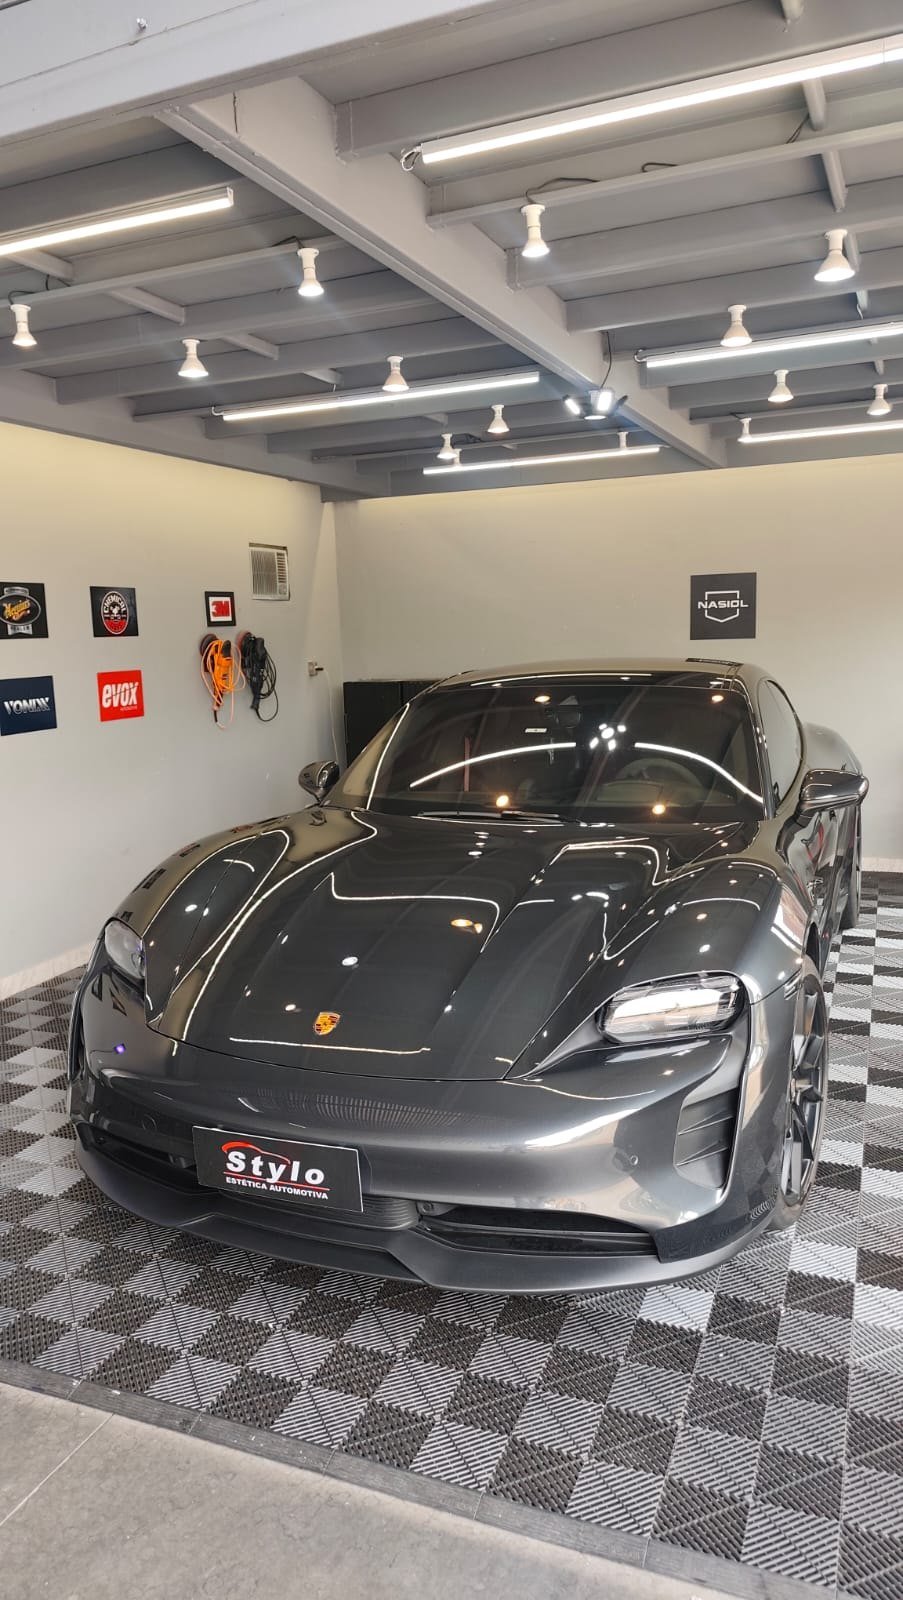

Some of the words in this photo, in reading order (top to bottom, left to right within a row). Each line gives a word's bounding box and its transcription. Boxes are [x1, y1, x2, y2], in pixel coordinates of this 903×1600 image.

[212, 600, 230, 617] 3M
[697, 600, 749, 609] NASIOL
[102, 681, 139, 708] evox
[226, 1150, 325, 1185] Stylo
[226, 1176, 267, 1190] ESTÉTICA
[269, 1184, 328, 1200] AUTOMOTIVA
